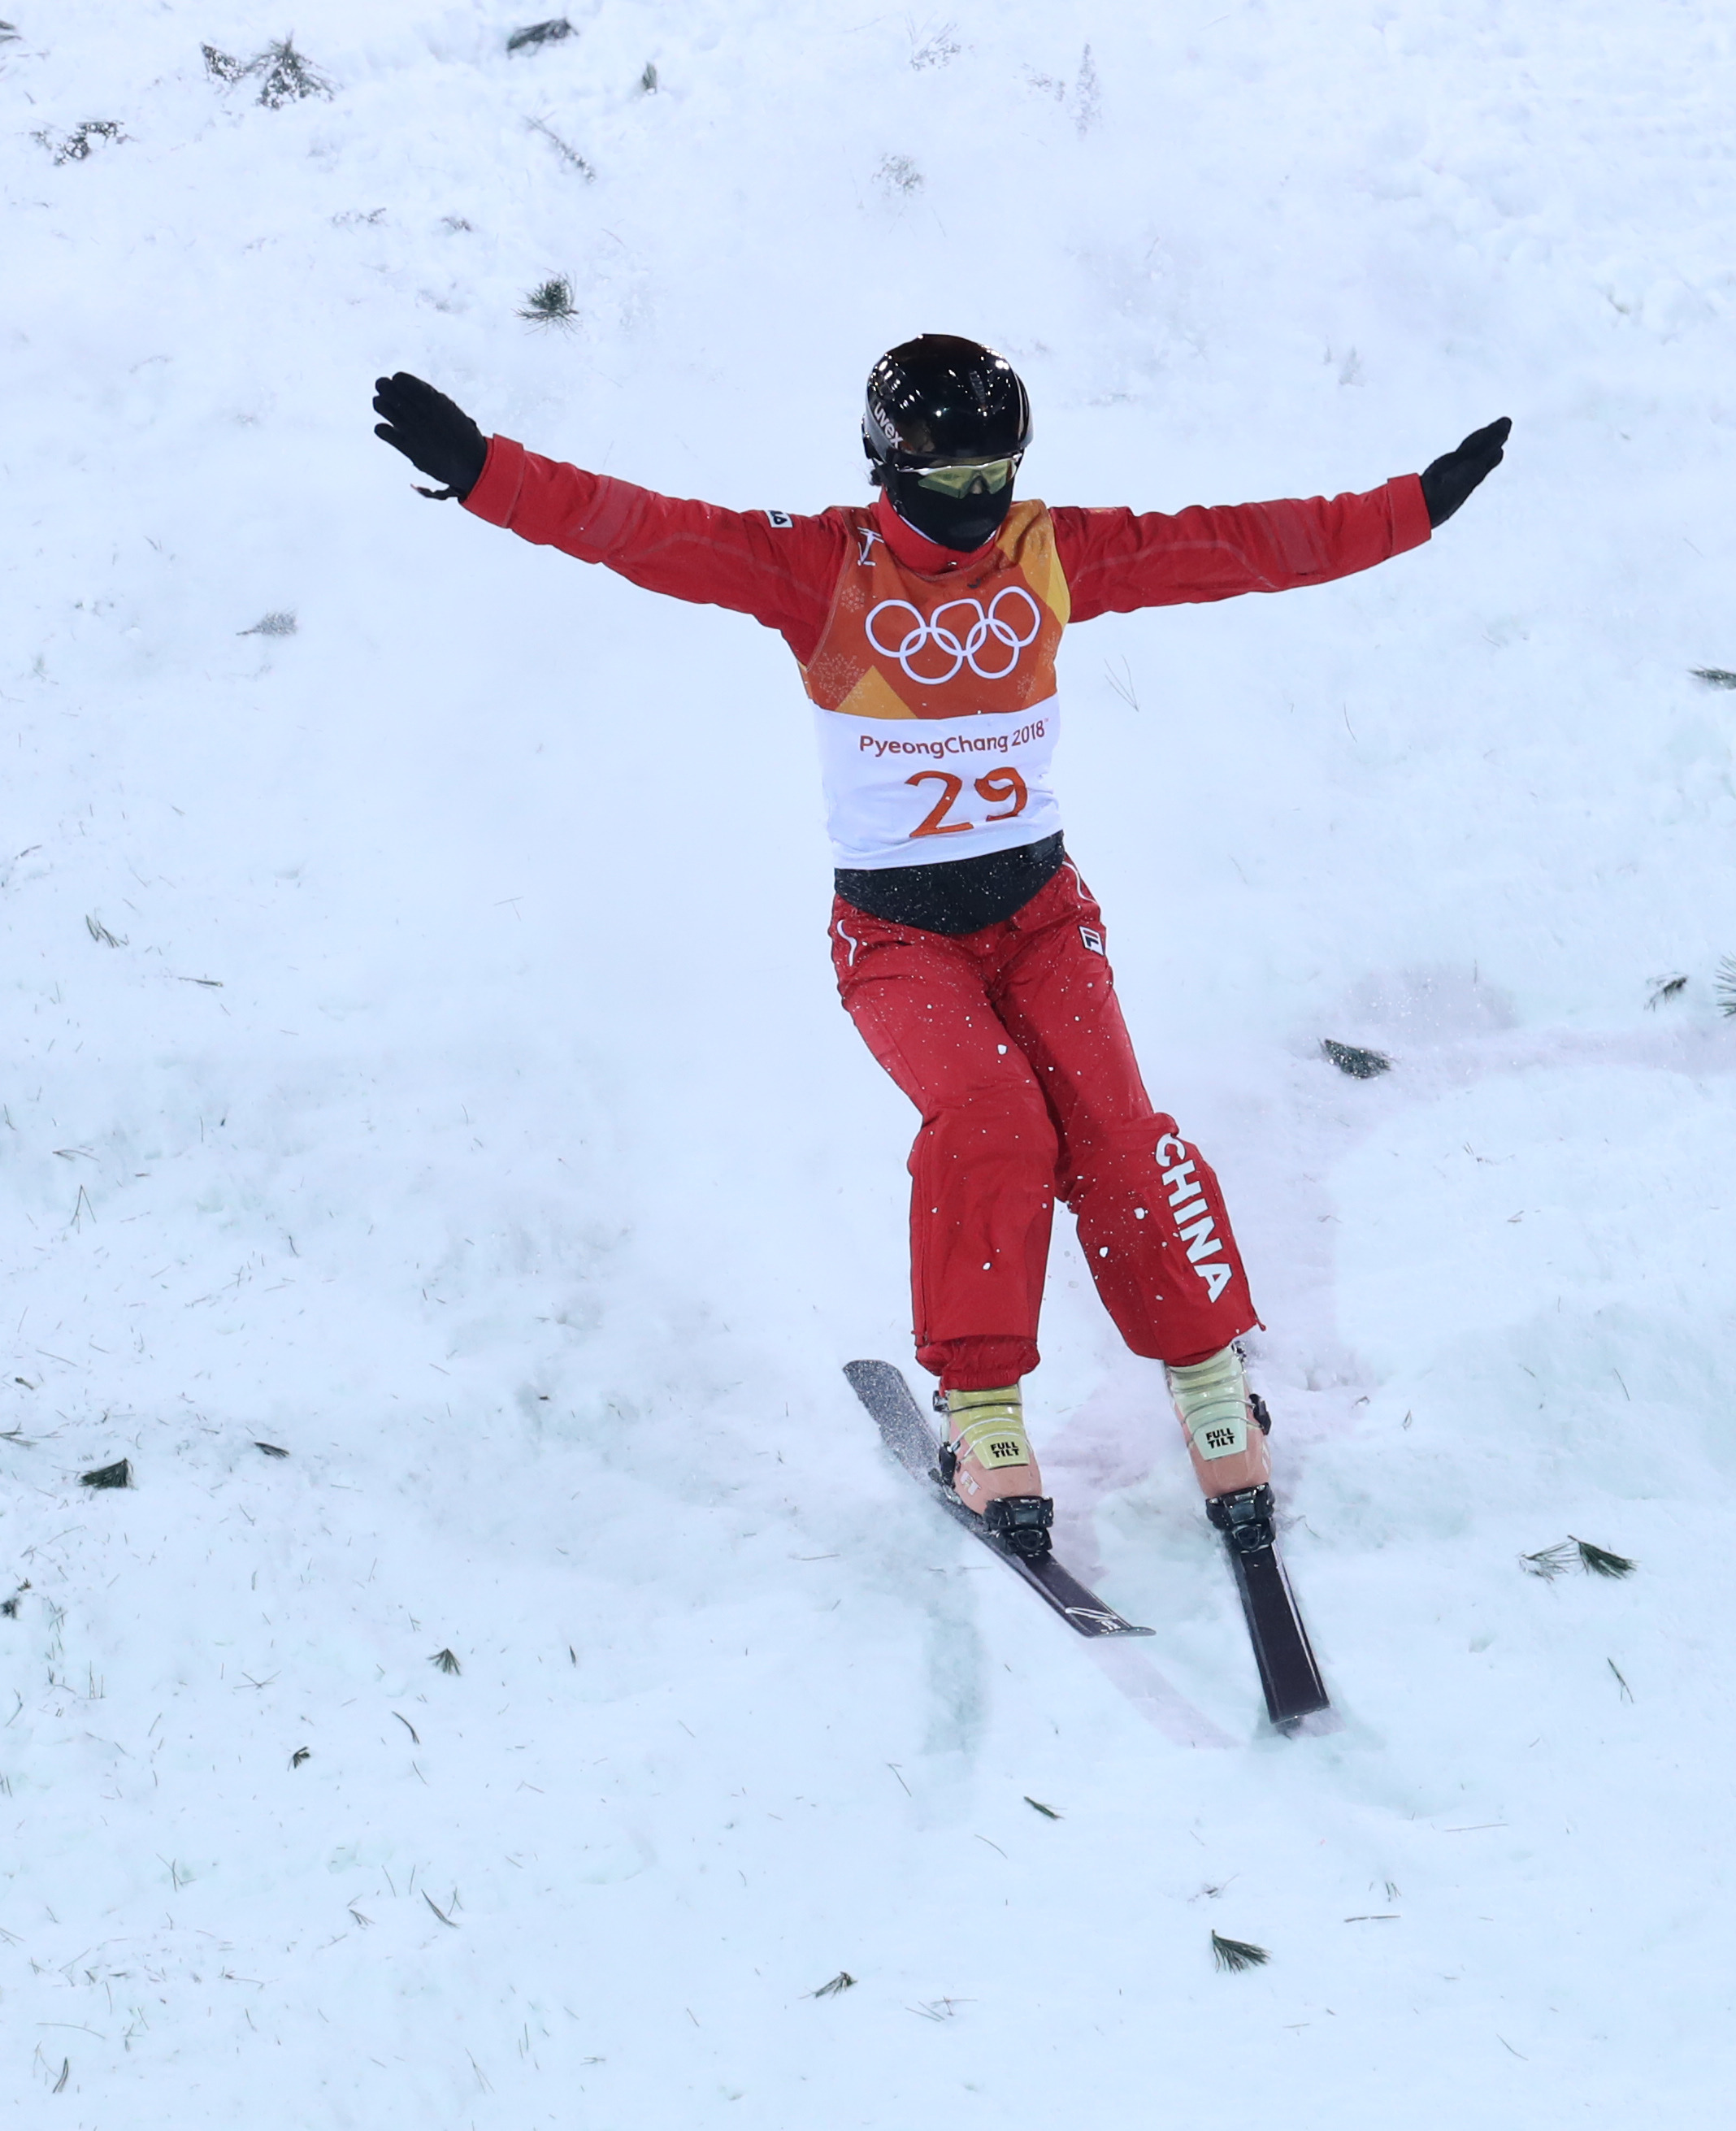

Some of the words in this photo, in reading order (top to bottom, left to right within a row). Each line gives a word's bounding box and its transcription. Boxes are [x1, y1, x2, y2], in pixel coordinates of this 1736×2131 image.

[874, 401, 904, 449] uvex
[860, 735, 1009, 759] PyeongChang
[905, 766, 1028, 838] 29
[1155, 1132, 1233, 1304] CHINA
[1205, 1427, 1234, 1441] FULL
[1208, 1435, 1235, 1449] TILT
[990, 1441, 1019, 1452] FULL
[992, 1448, 1019, 1458] TILT
